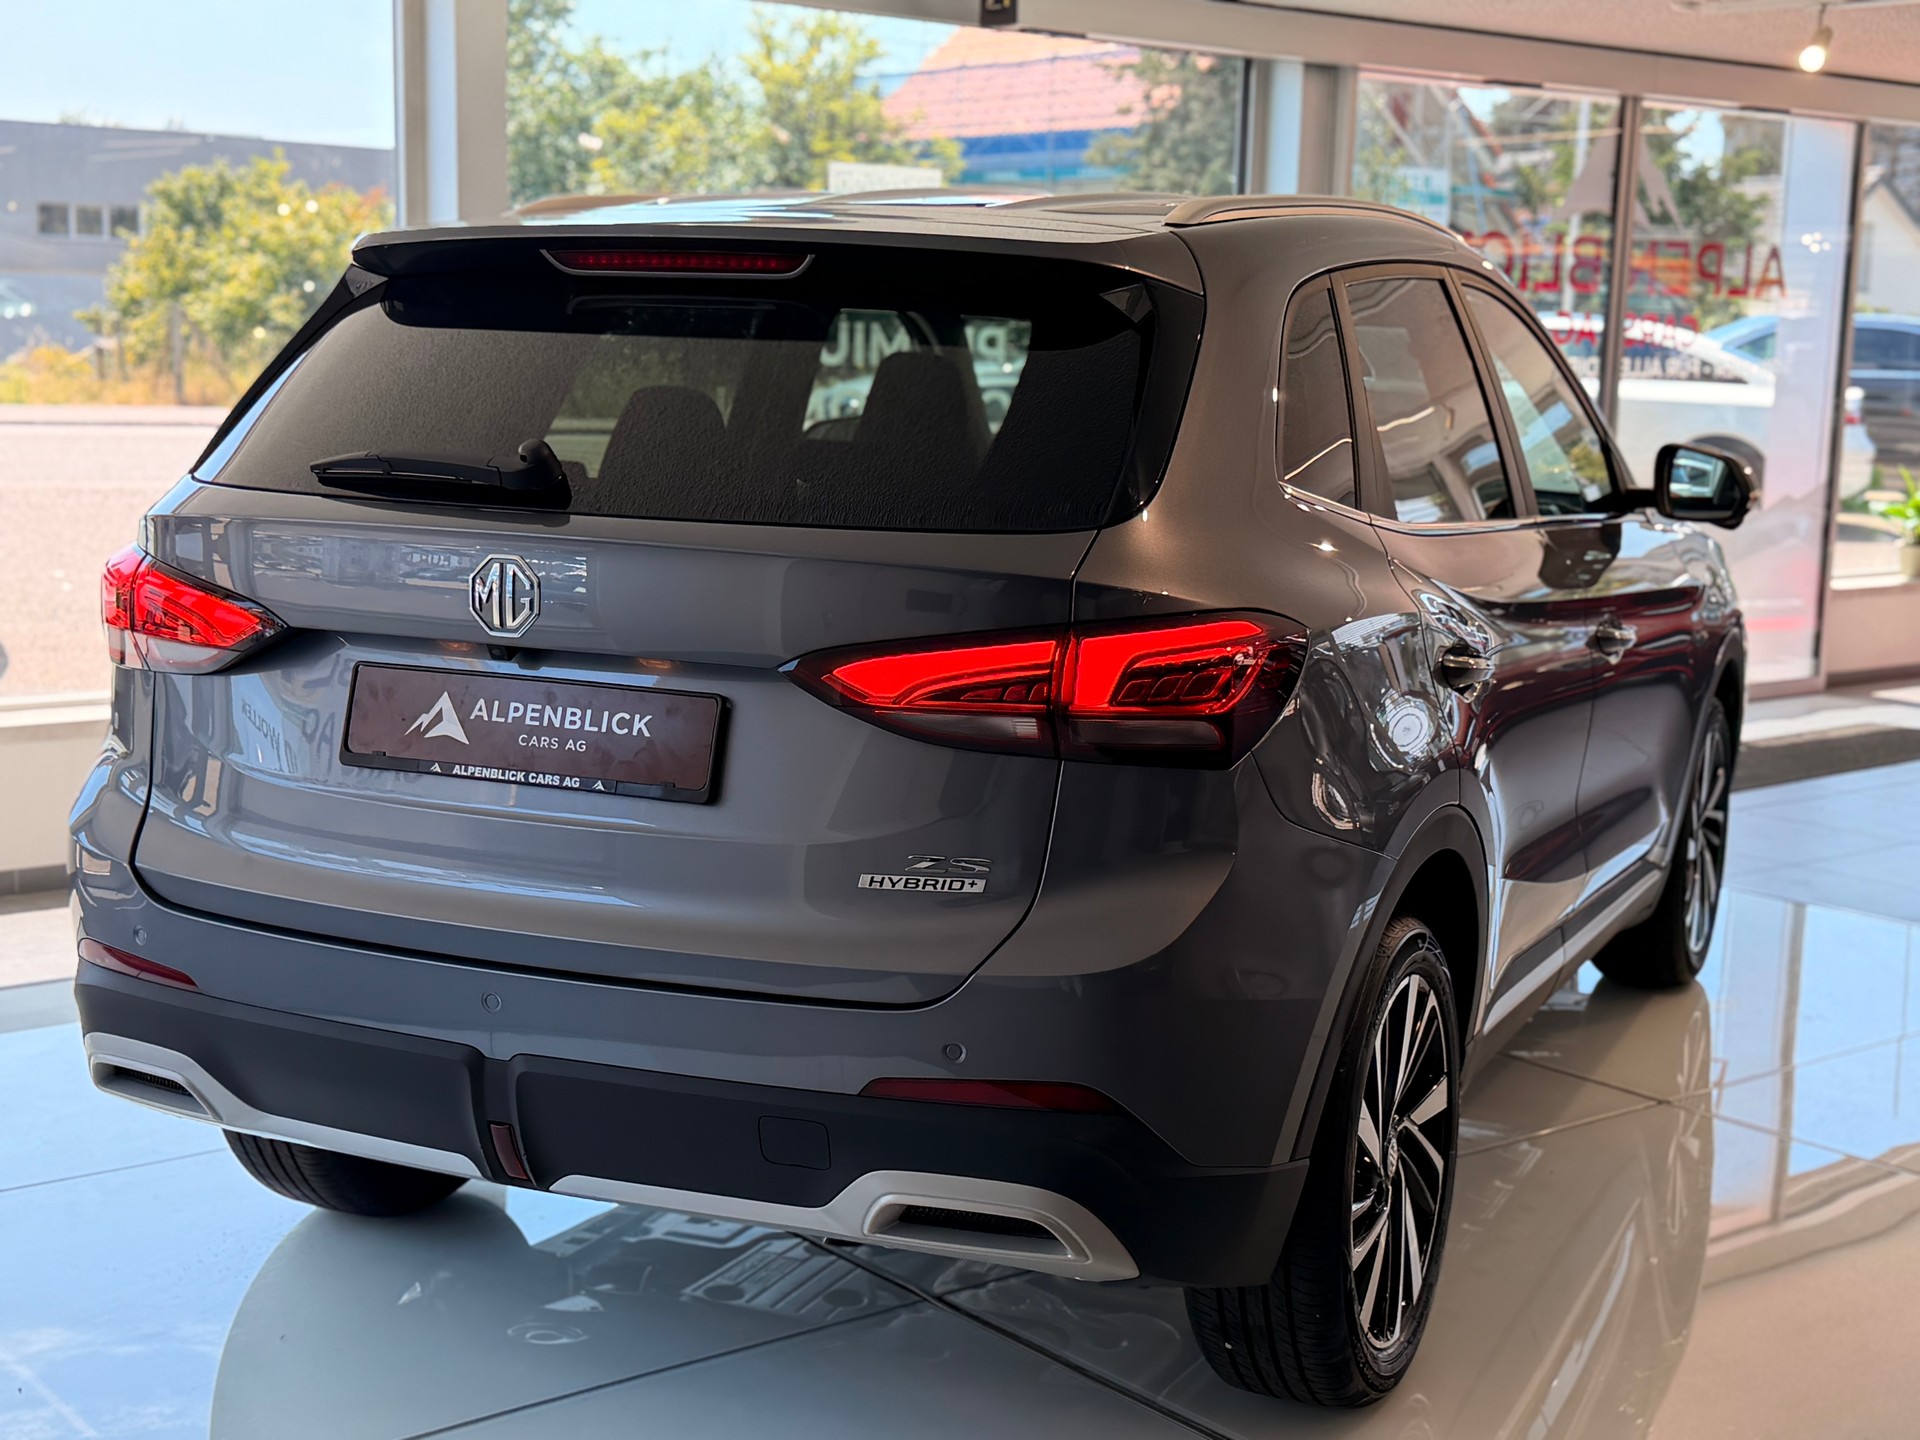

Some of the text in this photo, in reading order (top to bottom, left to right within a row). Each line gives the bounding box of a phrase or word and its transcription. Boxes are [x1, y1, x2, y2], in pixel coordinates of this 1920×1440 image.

[474, 561, 533, 630] MG
[470, 698, 653, 737] ALPENBLICK
[518, 734, 587, 752] CARS AG
[453, 765, 580, 788] ALPENBLICK CARS AG
[905, 855, 992, 874] ZS
[868, 875, 978, 892] HYBRID+
